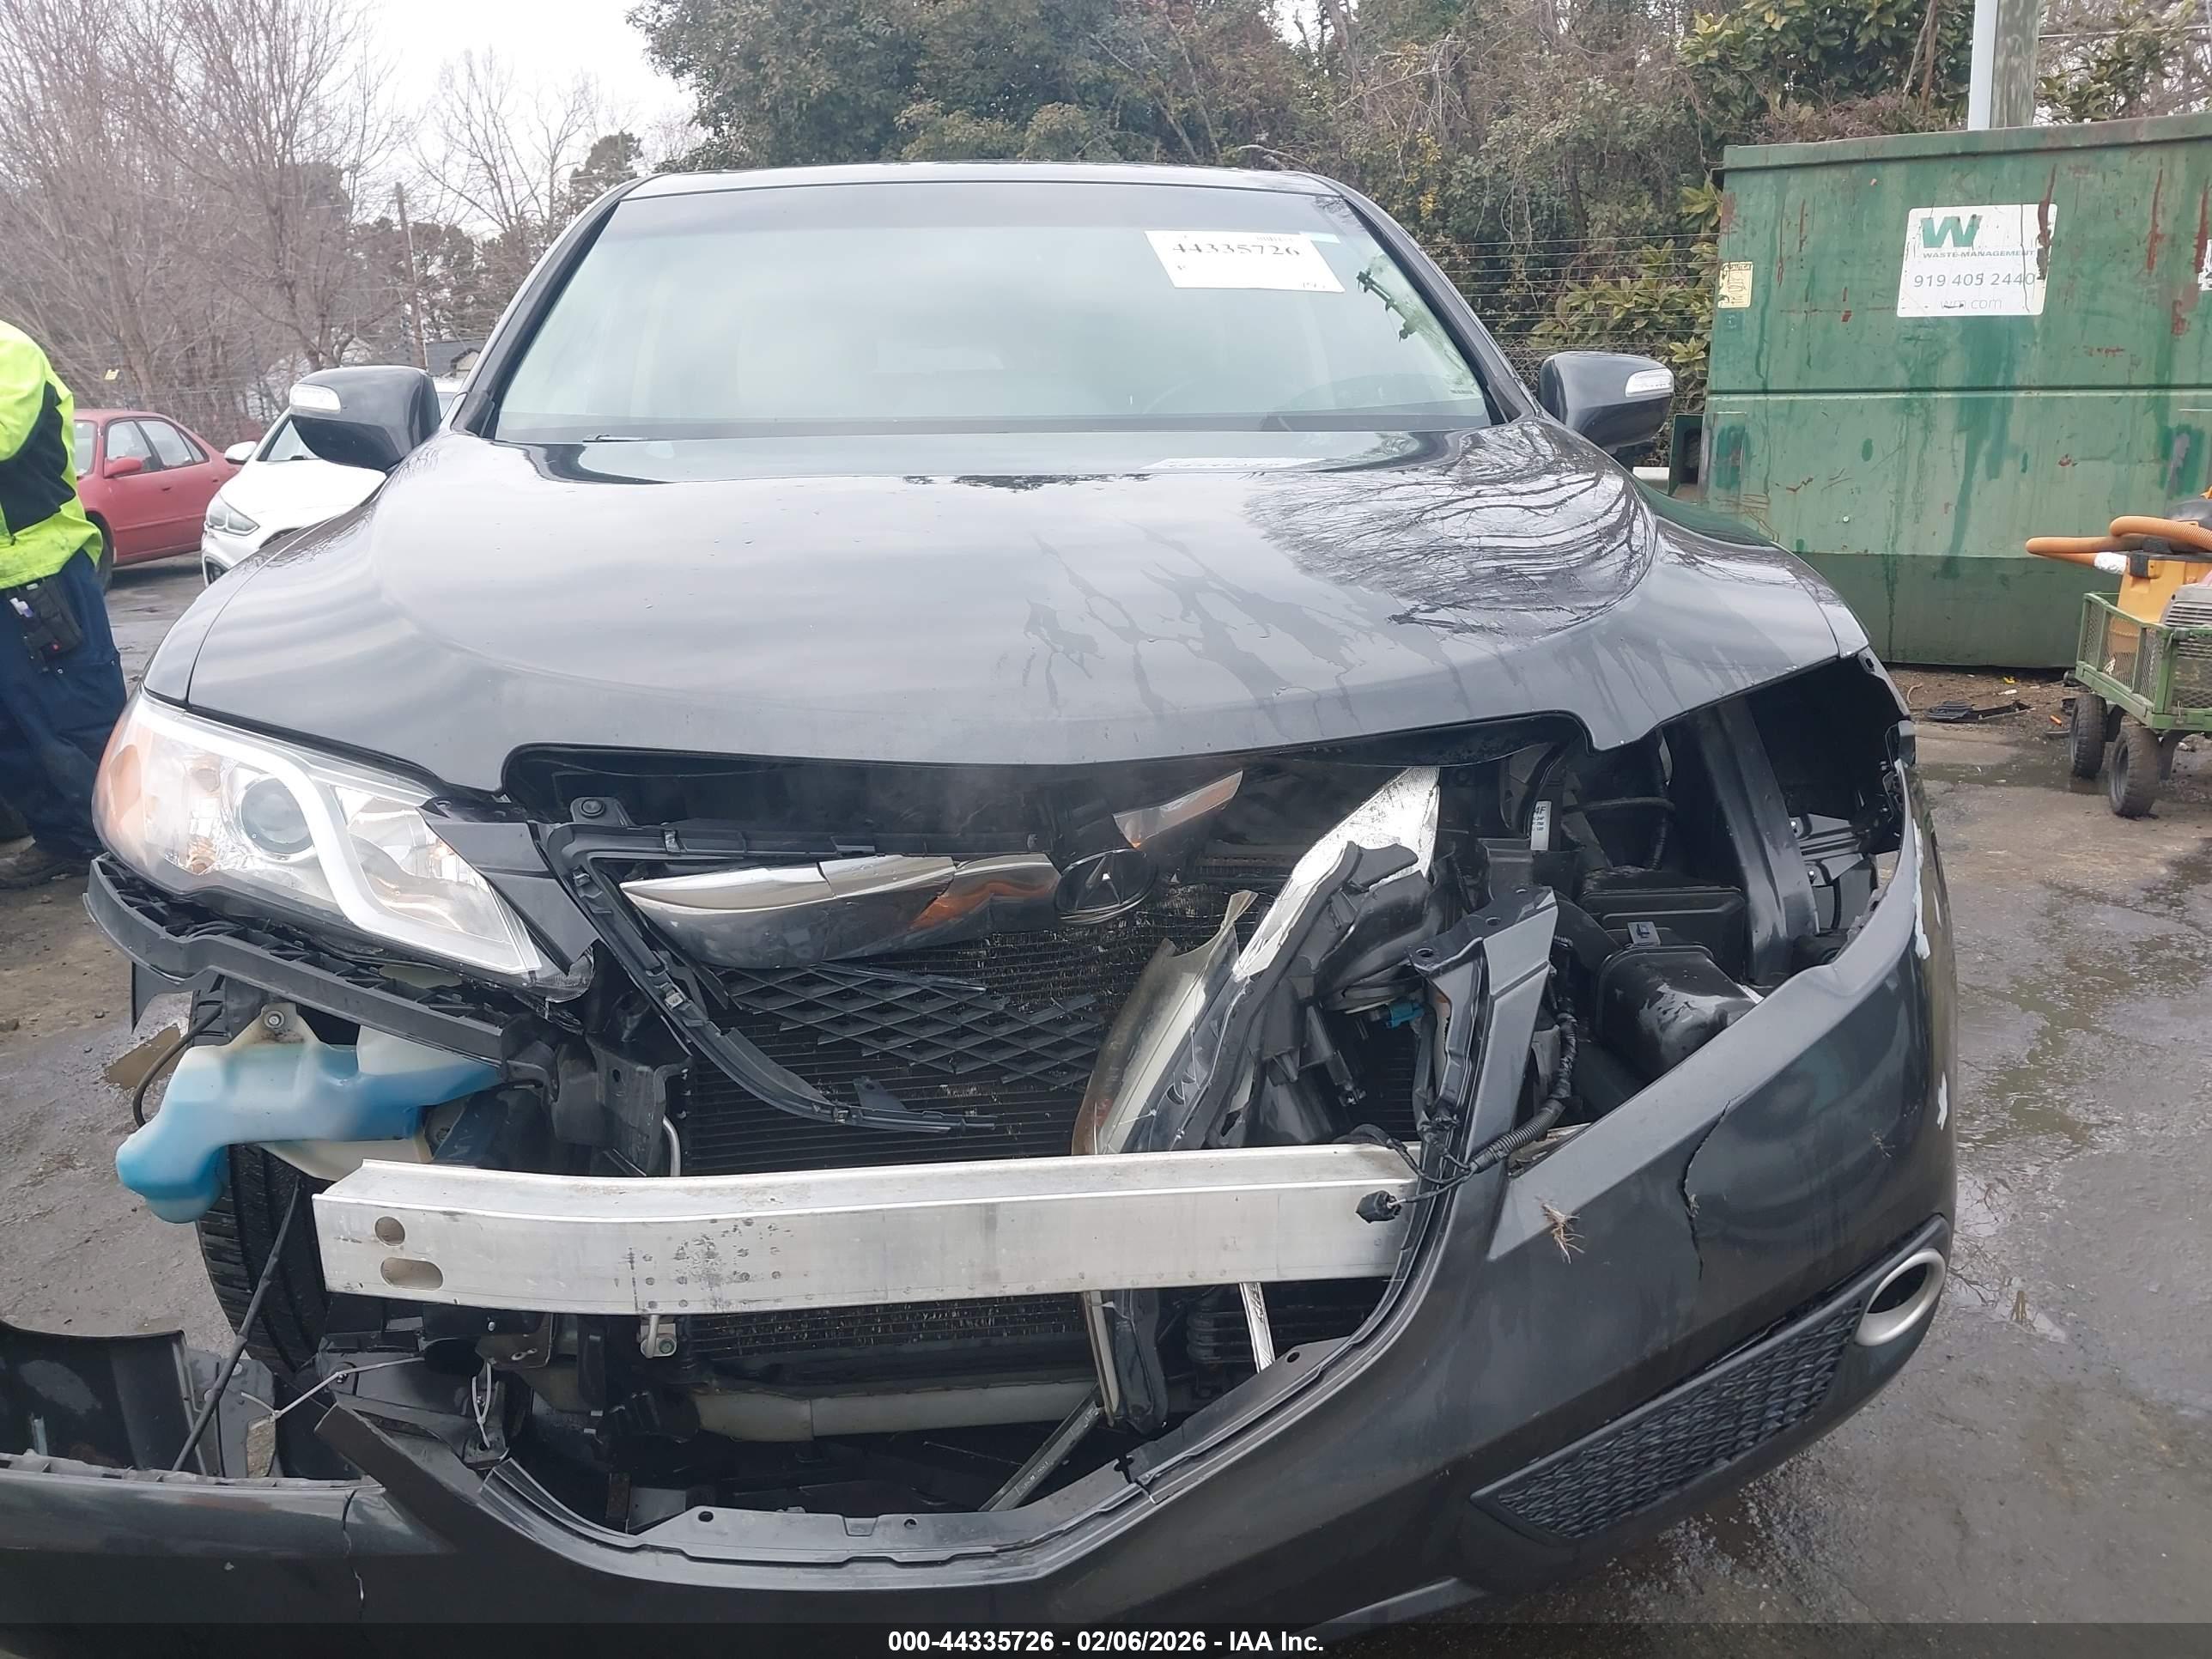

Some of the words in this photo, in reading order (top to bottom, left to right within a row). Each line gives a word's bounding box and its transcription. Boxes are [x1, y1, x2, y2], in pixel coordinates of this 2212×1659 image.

[1173, 243, 1301, 256] 44335726
[1914, 274, 1946, 288] 919
[1990, 272, 2036, 286] 2440
